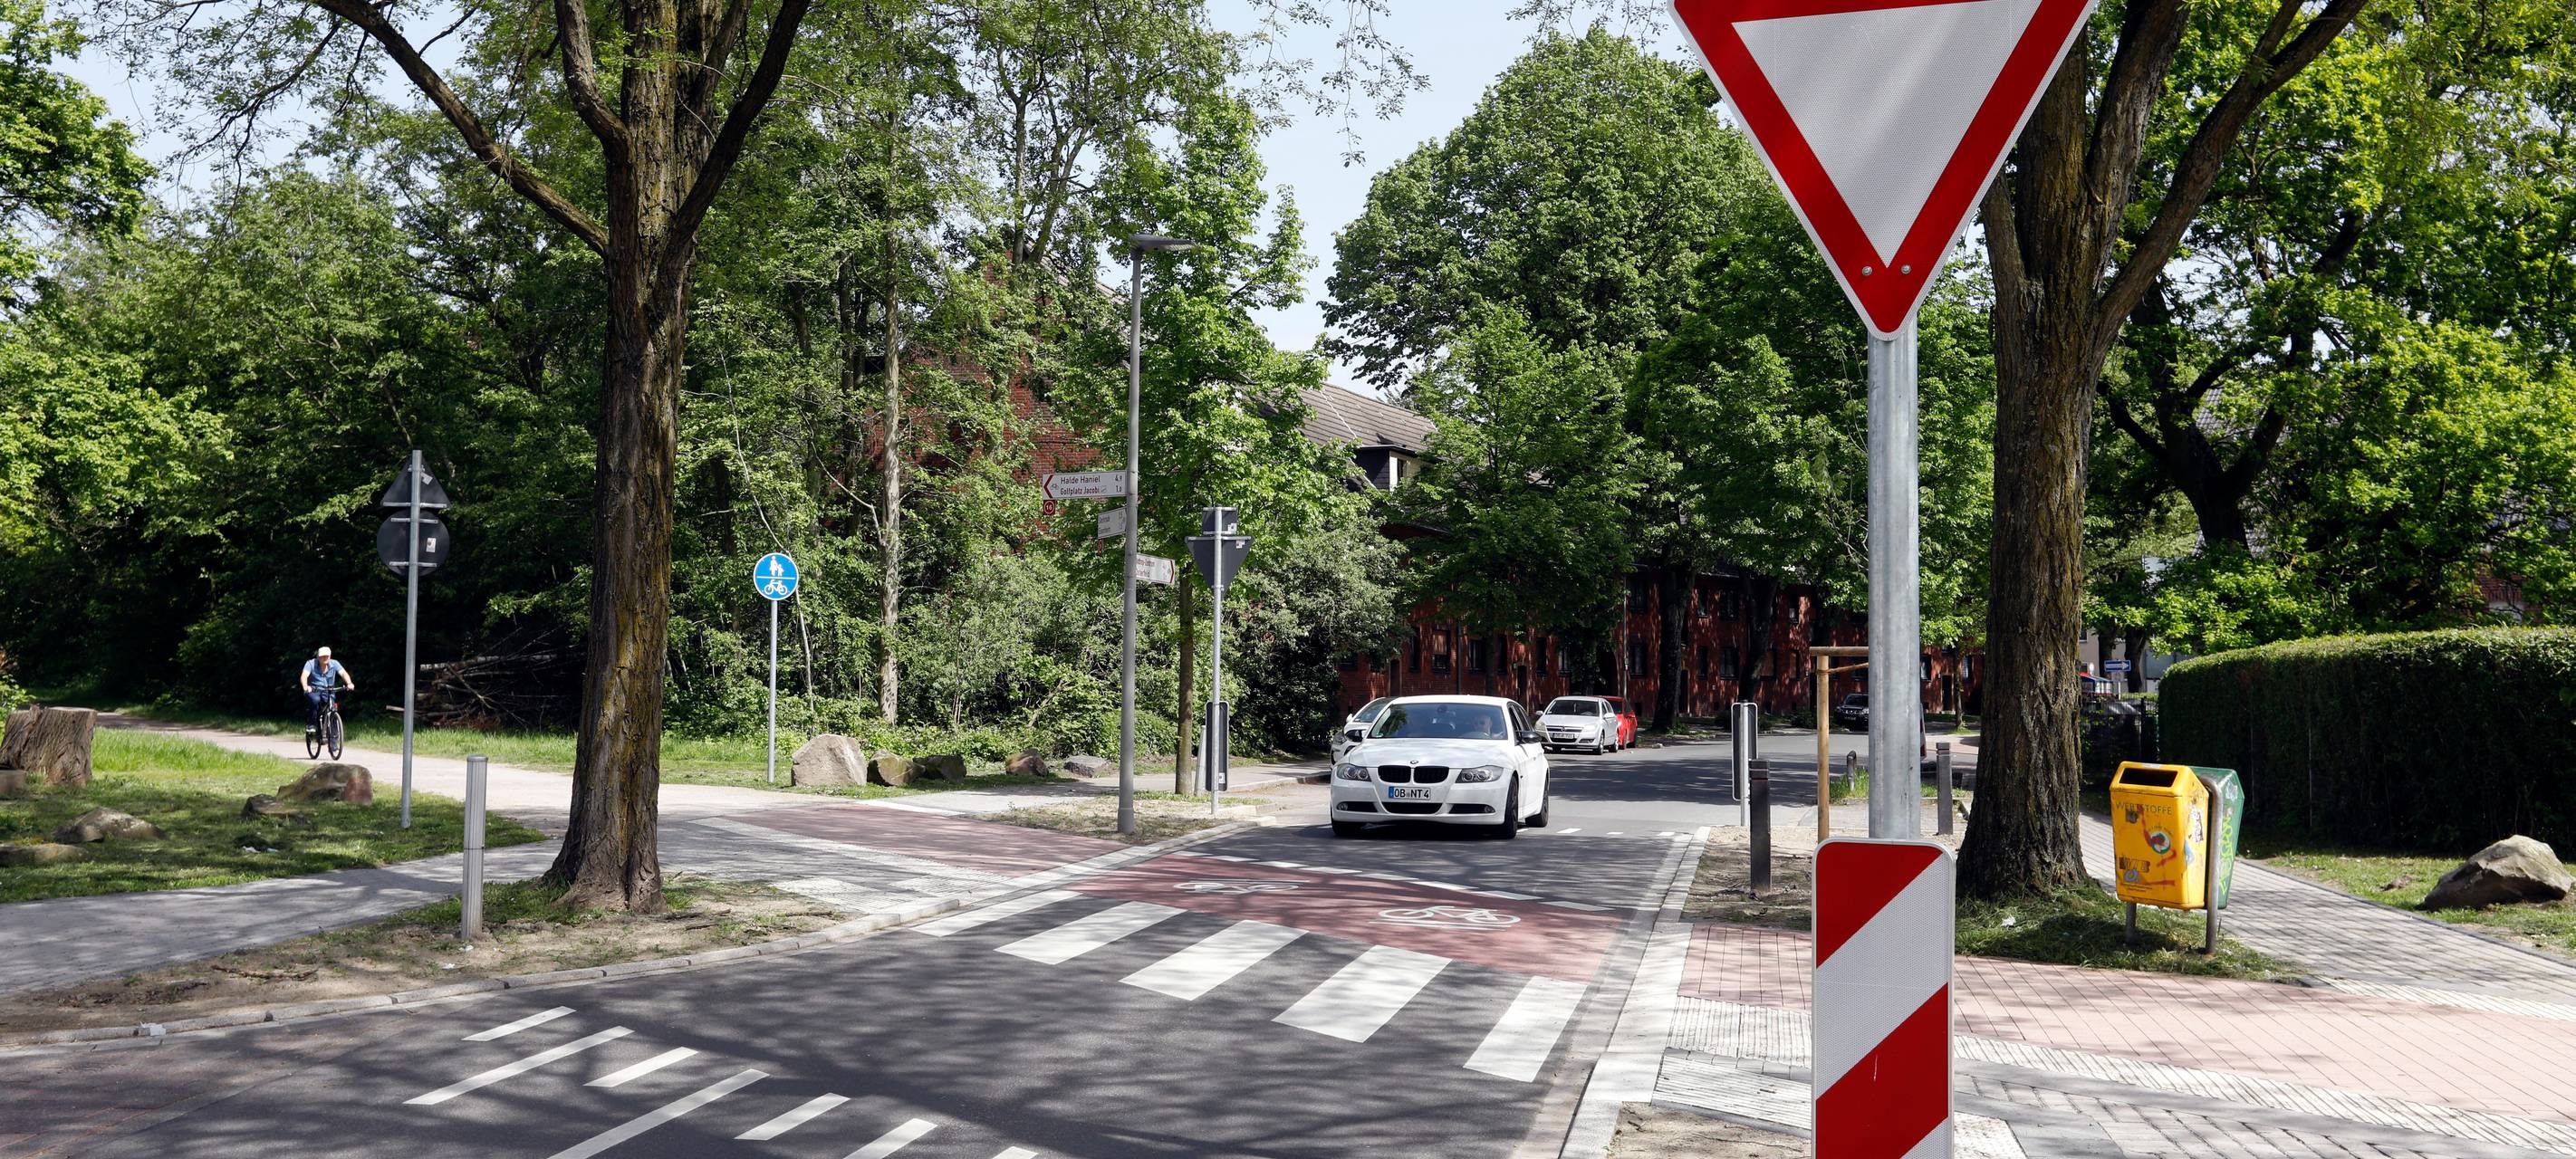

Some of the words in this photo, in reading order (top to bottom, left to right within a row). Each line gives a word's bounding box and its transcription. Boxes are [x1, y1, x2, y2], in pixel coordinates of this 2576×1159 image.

[1060, 476, 1079, 484] Halde
[1080, 475, 1101, 484] Haniel
[1060, 487, 1082, 496] Golfplatz
[1083, 486, 1100, 494] Jacobi
[1394, 788, 1406, 798] OB
